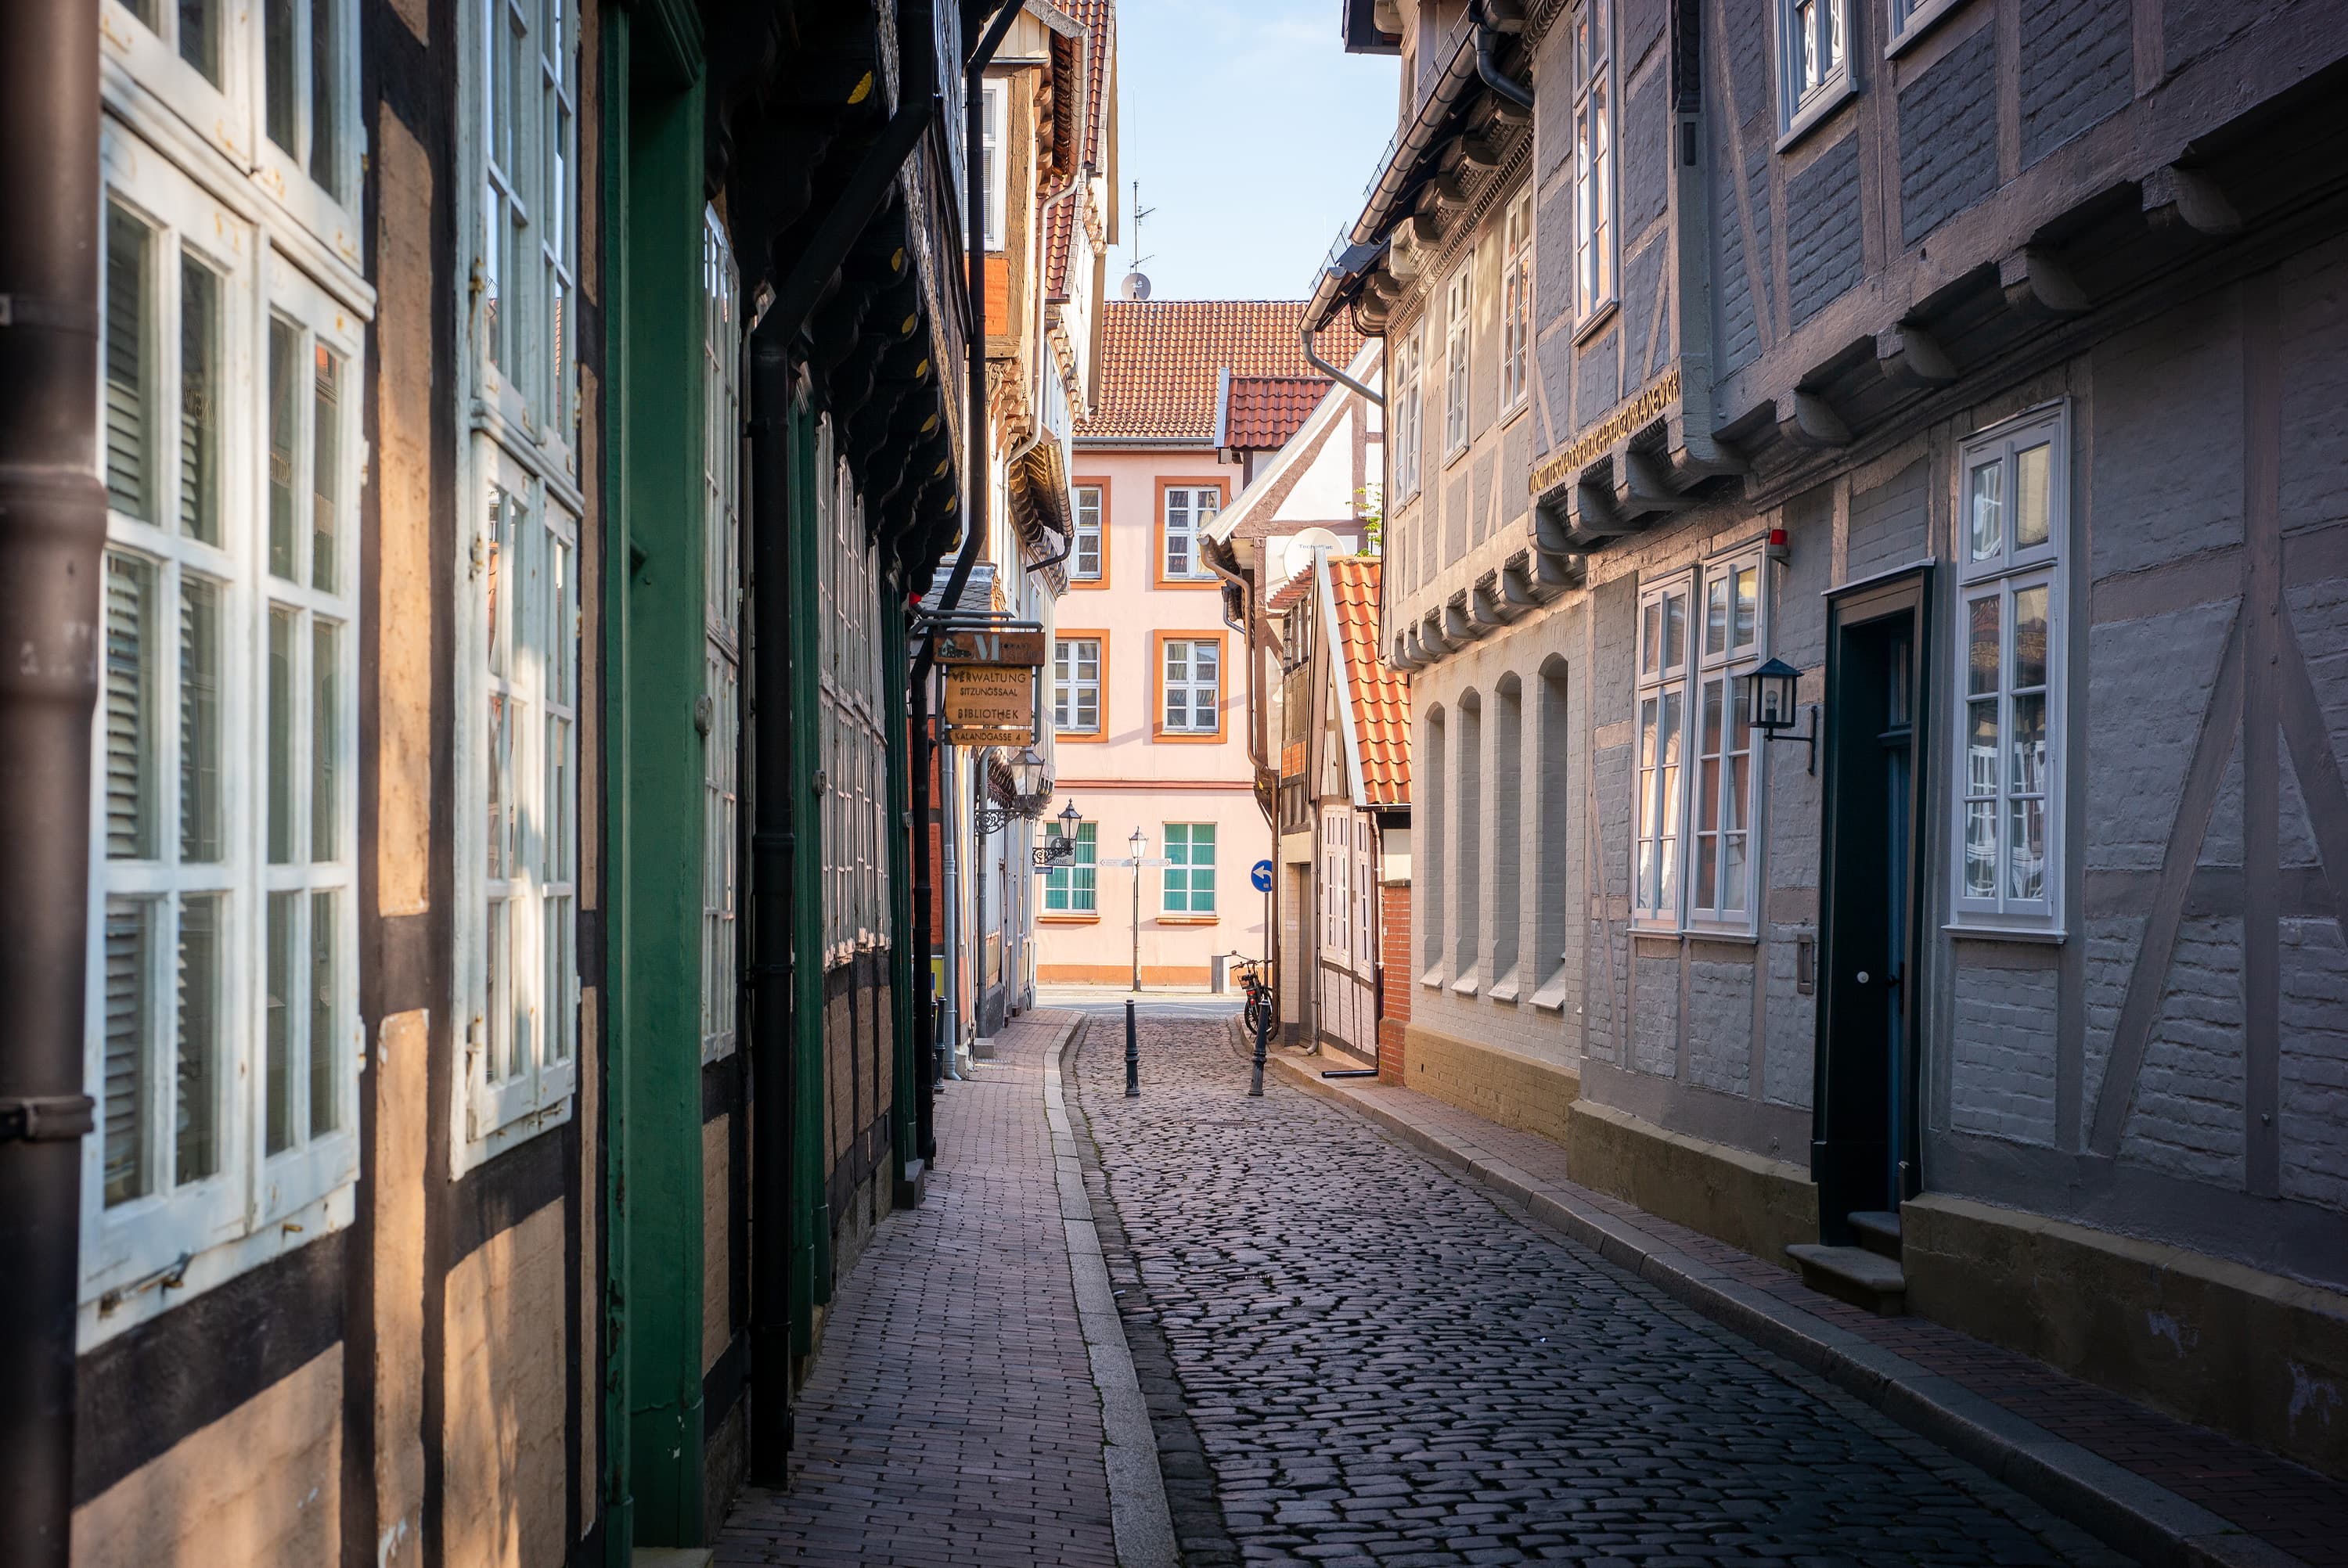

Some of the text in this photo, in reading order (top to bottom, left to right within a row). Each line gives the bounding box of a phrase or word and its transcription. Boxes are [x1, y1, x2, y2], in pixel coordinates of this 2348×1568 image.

[953, 673, 1026, 683] VERWALTUNG
[960, 688, 1017, 696] SITZUNGSSAAL
[957, 709, 1019, 720] BIBLIOTHEK
[956, 732, 1011, 741] KALANDGASSE
